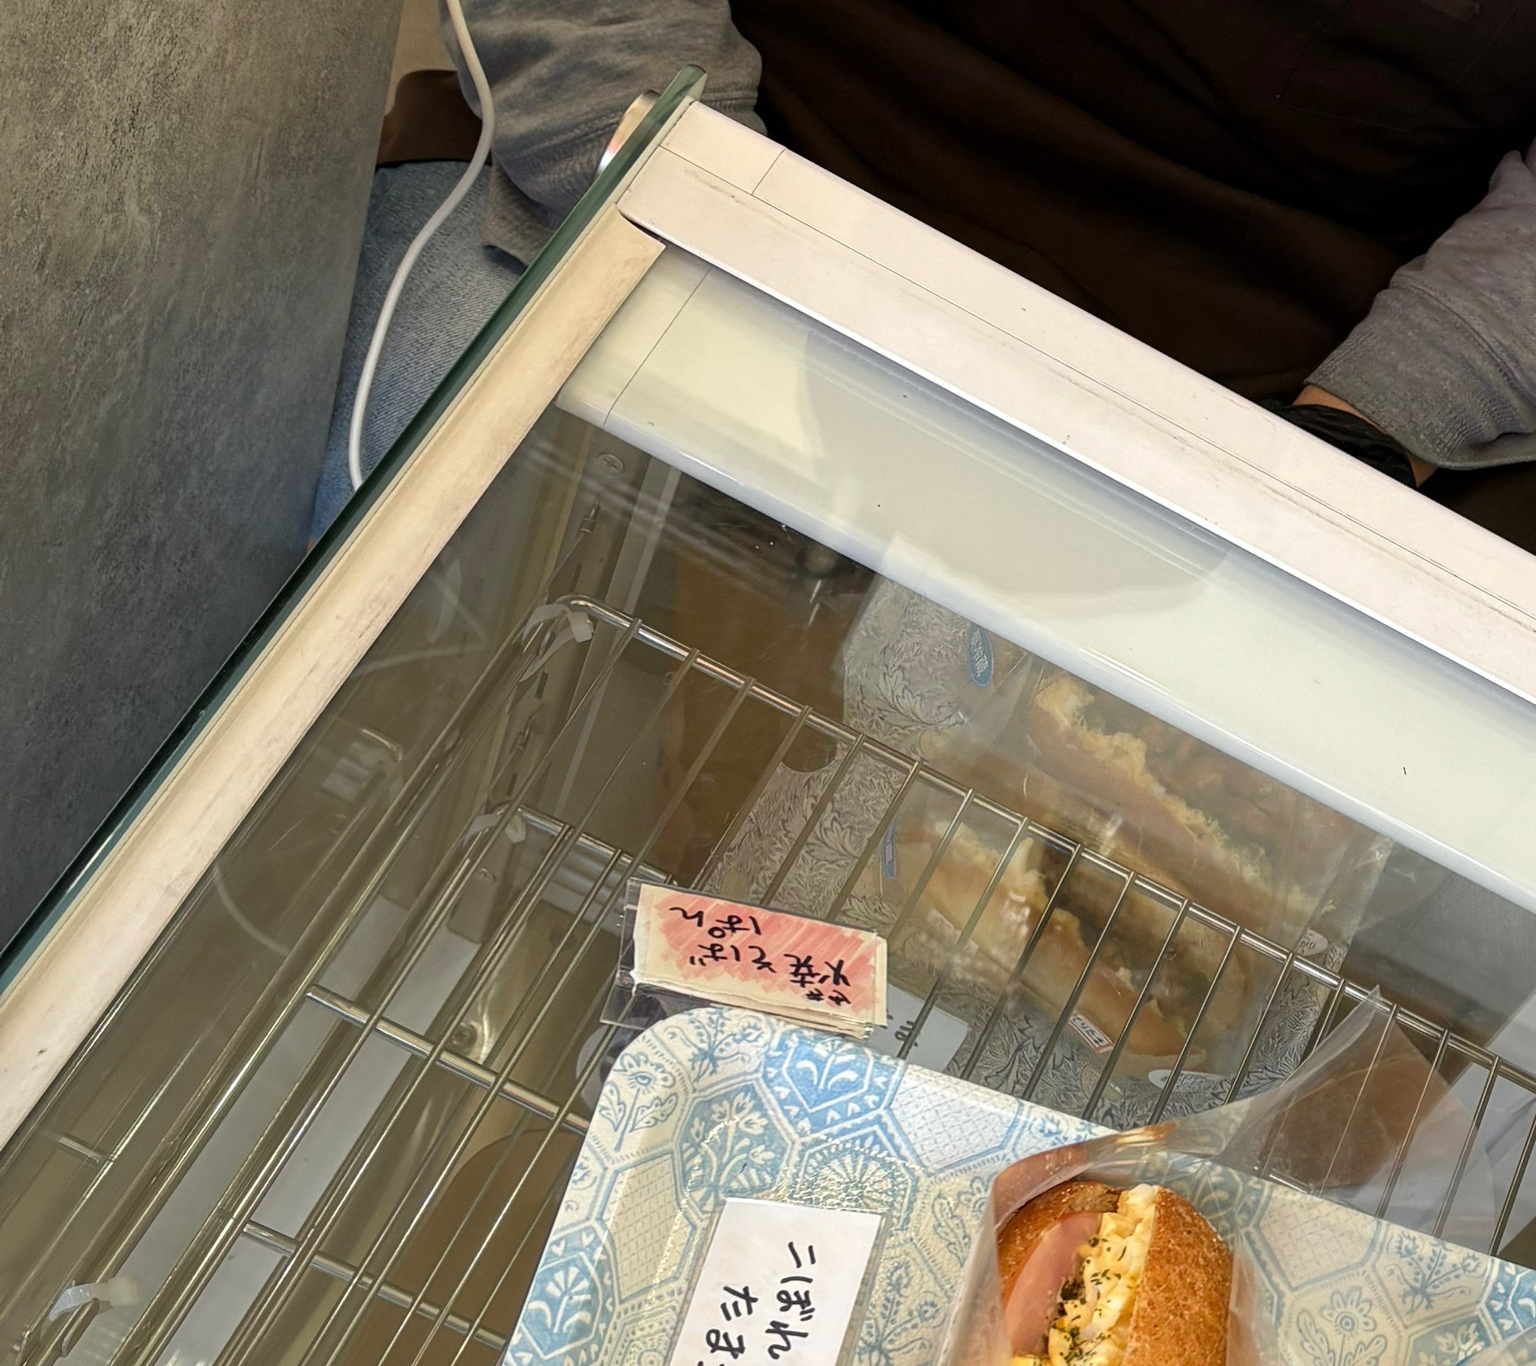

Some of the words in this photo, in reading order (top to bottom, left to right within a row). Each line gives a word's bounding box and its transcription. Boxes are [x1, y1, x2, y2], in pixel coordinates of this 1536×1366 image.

[669, 907, 762, 939] ぱん
[689, 943, 852, 989] 焼そば
[765, 1241, 817, 1360] こぼれ
